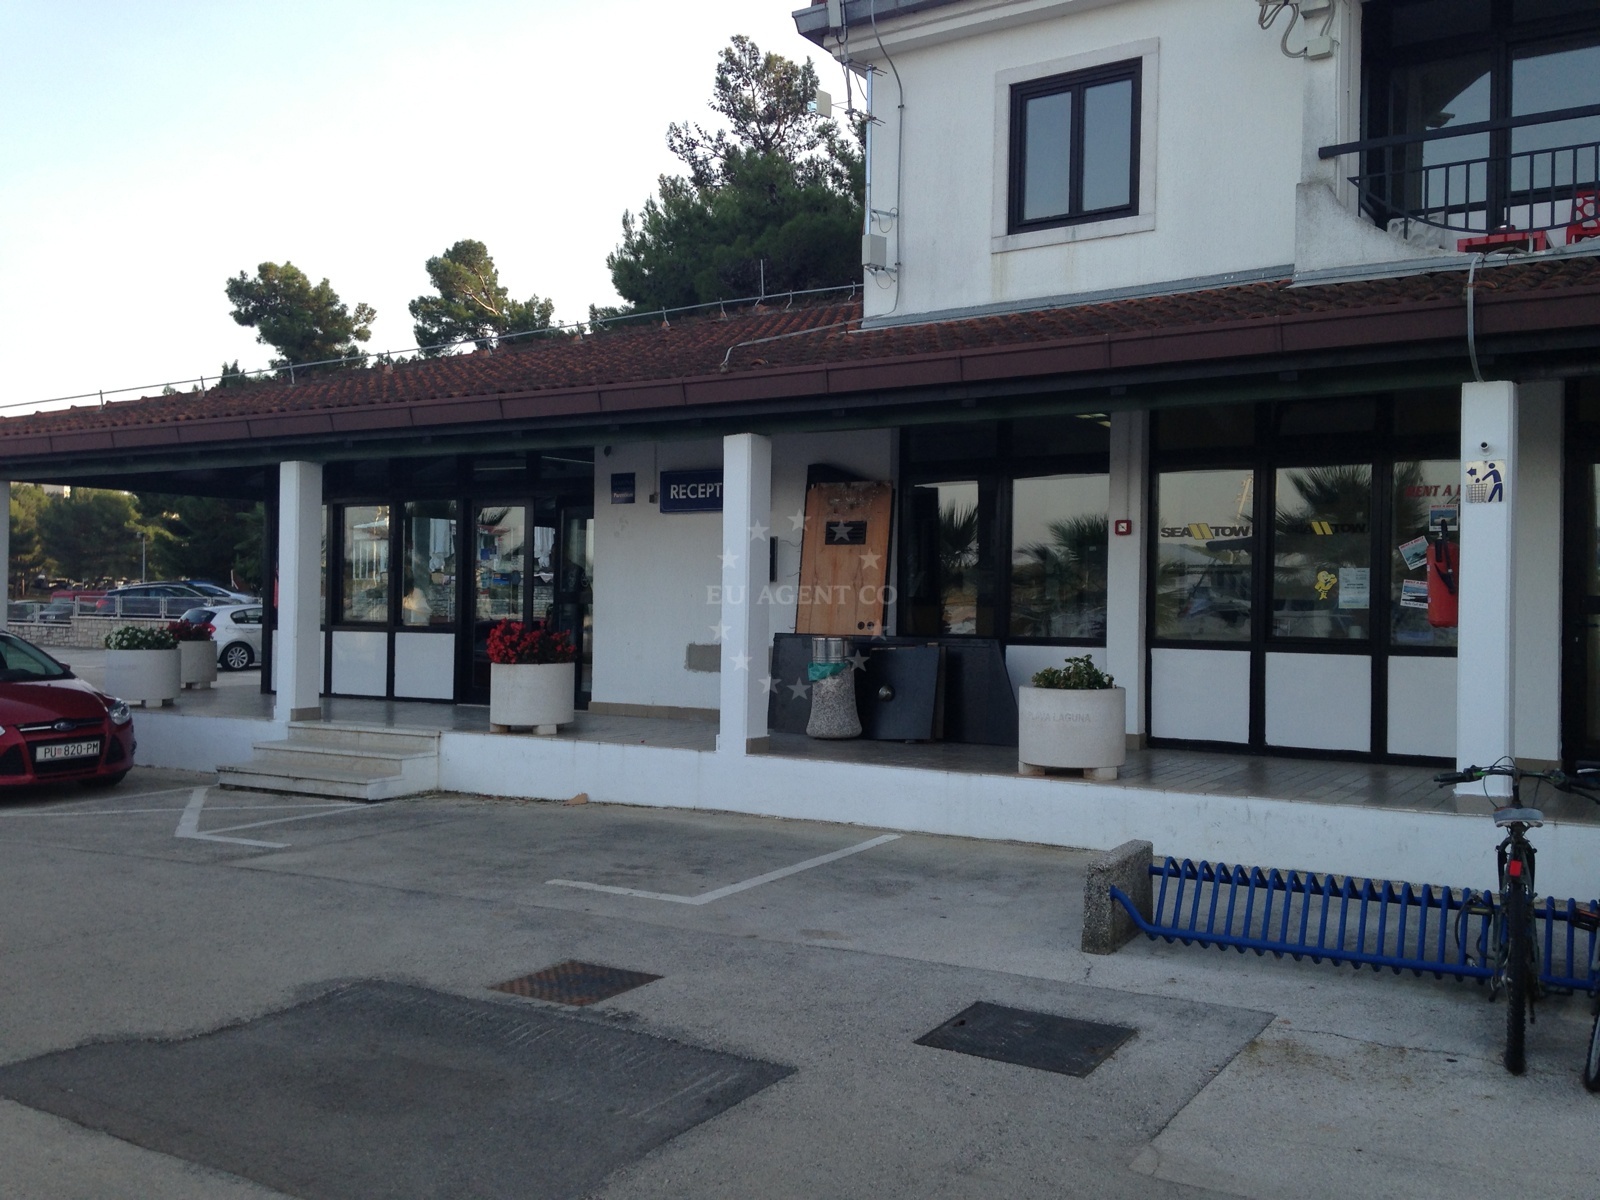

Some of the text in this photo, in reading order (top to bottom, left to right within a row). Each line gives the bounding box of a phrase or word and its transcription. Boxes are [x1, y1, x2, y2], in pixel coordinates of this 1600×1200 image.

[1442, 484, 1453, 497] A
[1160, 526, 1250, 538] SEA TOW
[44, 742, 99, 759] PU 820-PM
